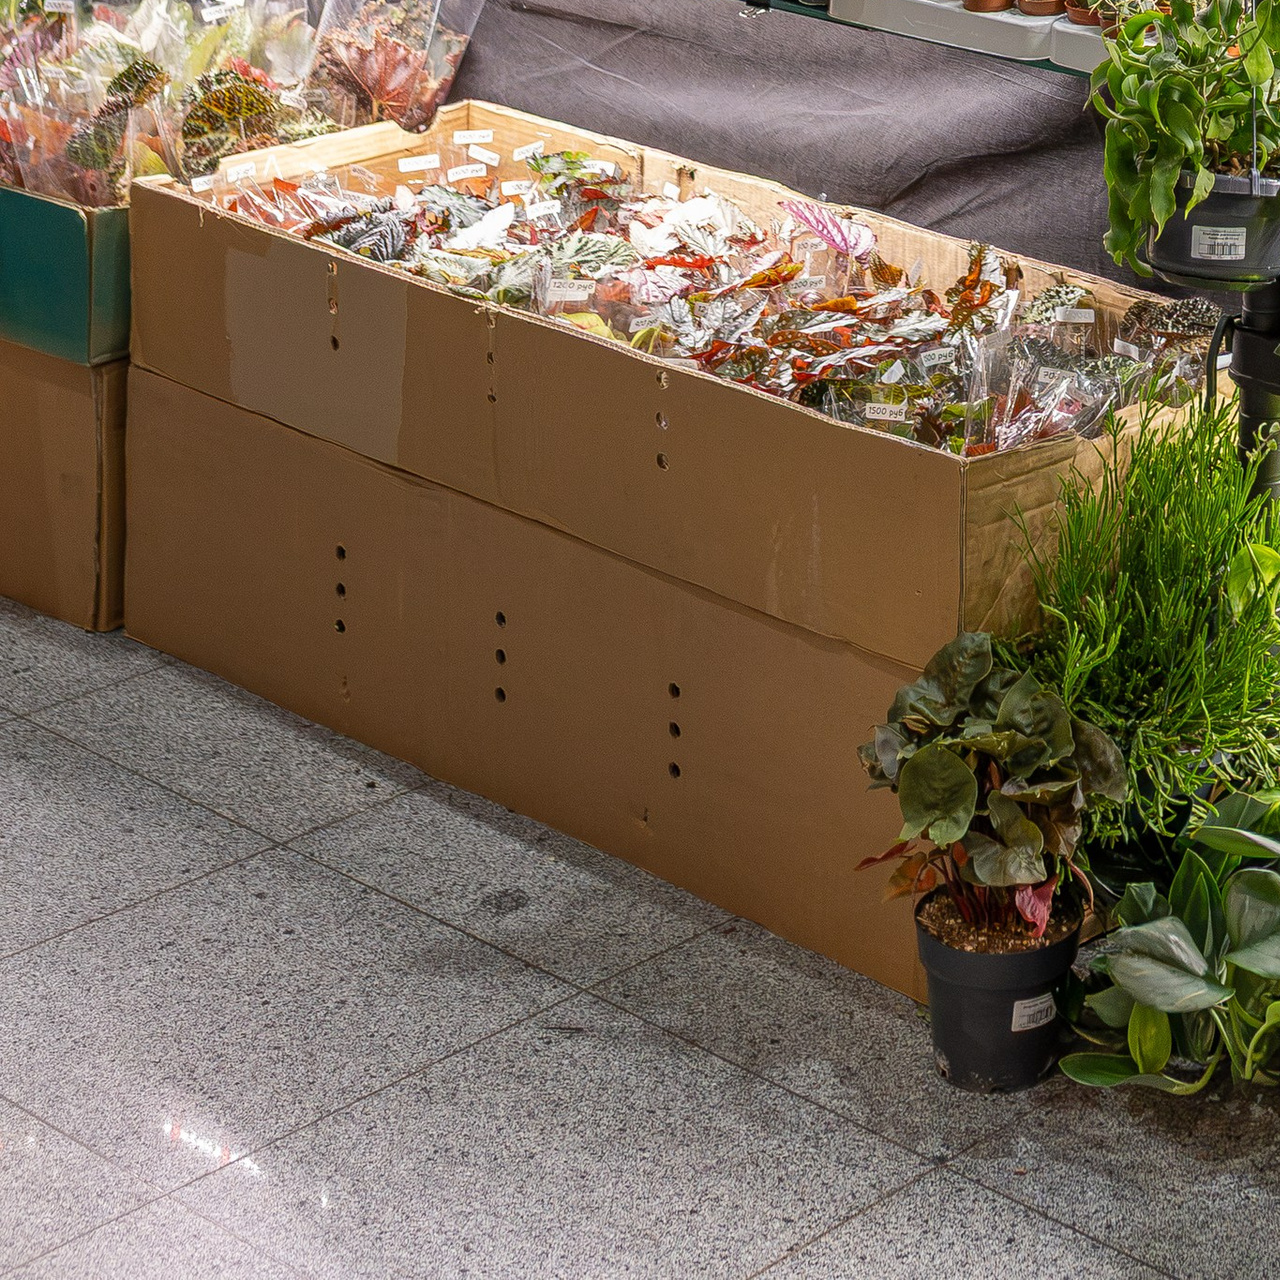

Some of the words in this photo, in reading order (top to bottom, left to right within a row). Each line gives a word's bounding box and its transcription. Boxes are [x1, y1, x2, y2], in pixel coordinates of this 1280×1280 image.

[577, 283, 594, 291] руб
[937, 349, 954, 363] руб
[868, 406, 887, 417] 1500
[889, 409, 904, 420] руб
